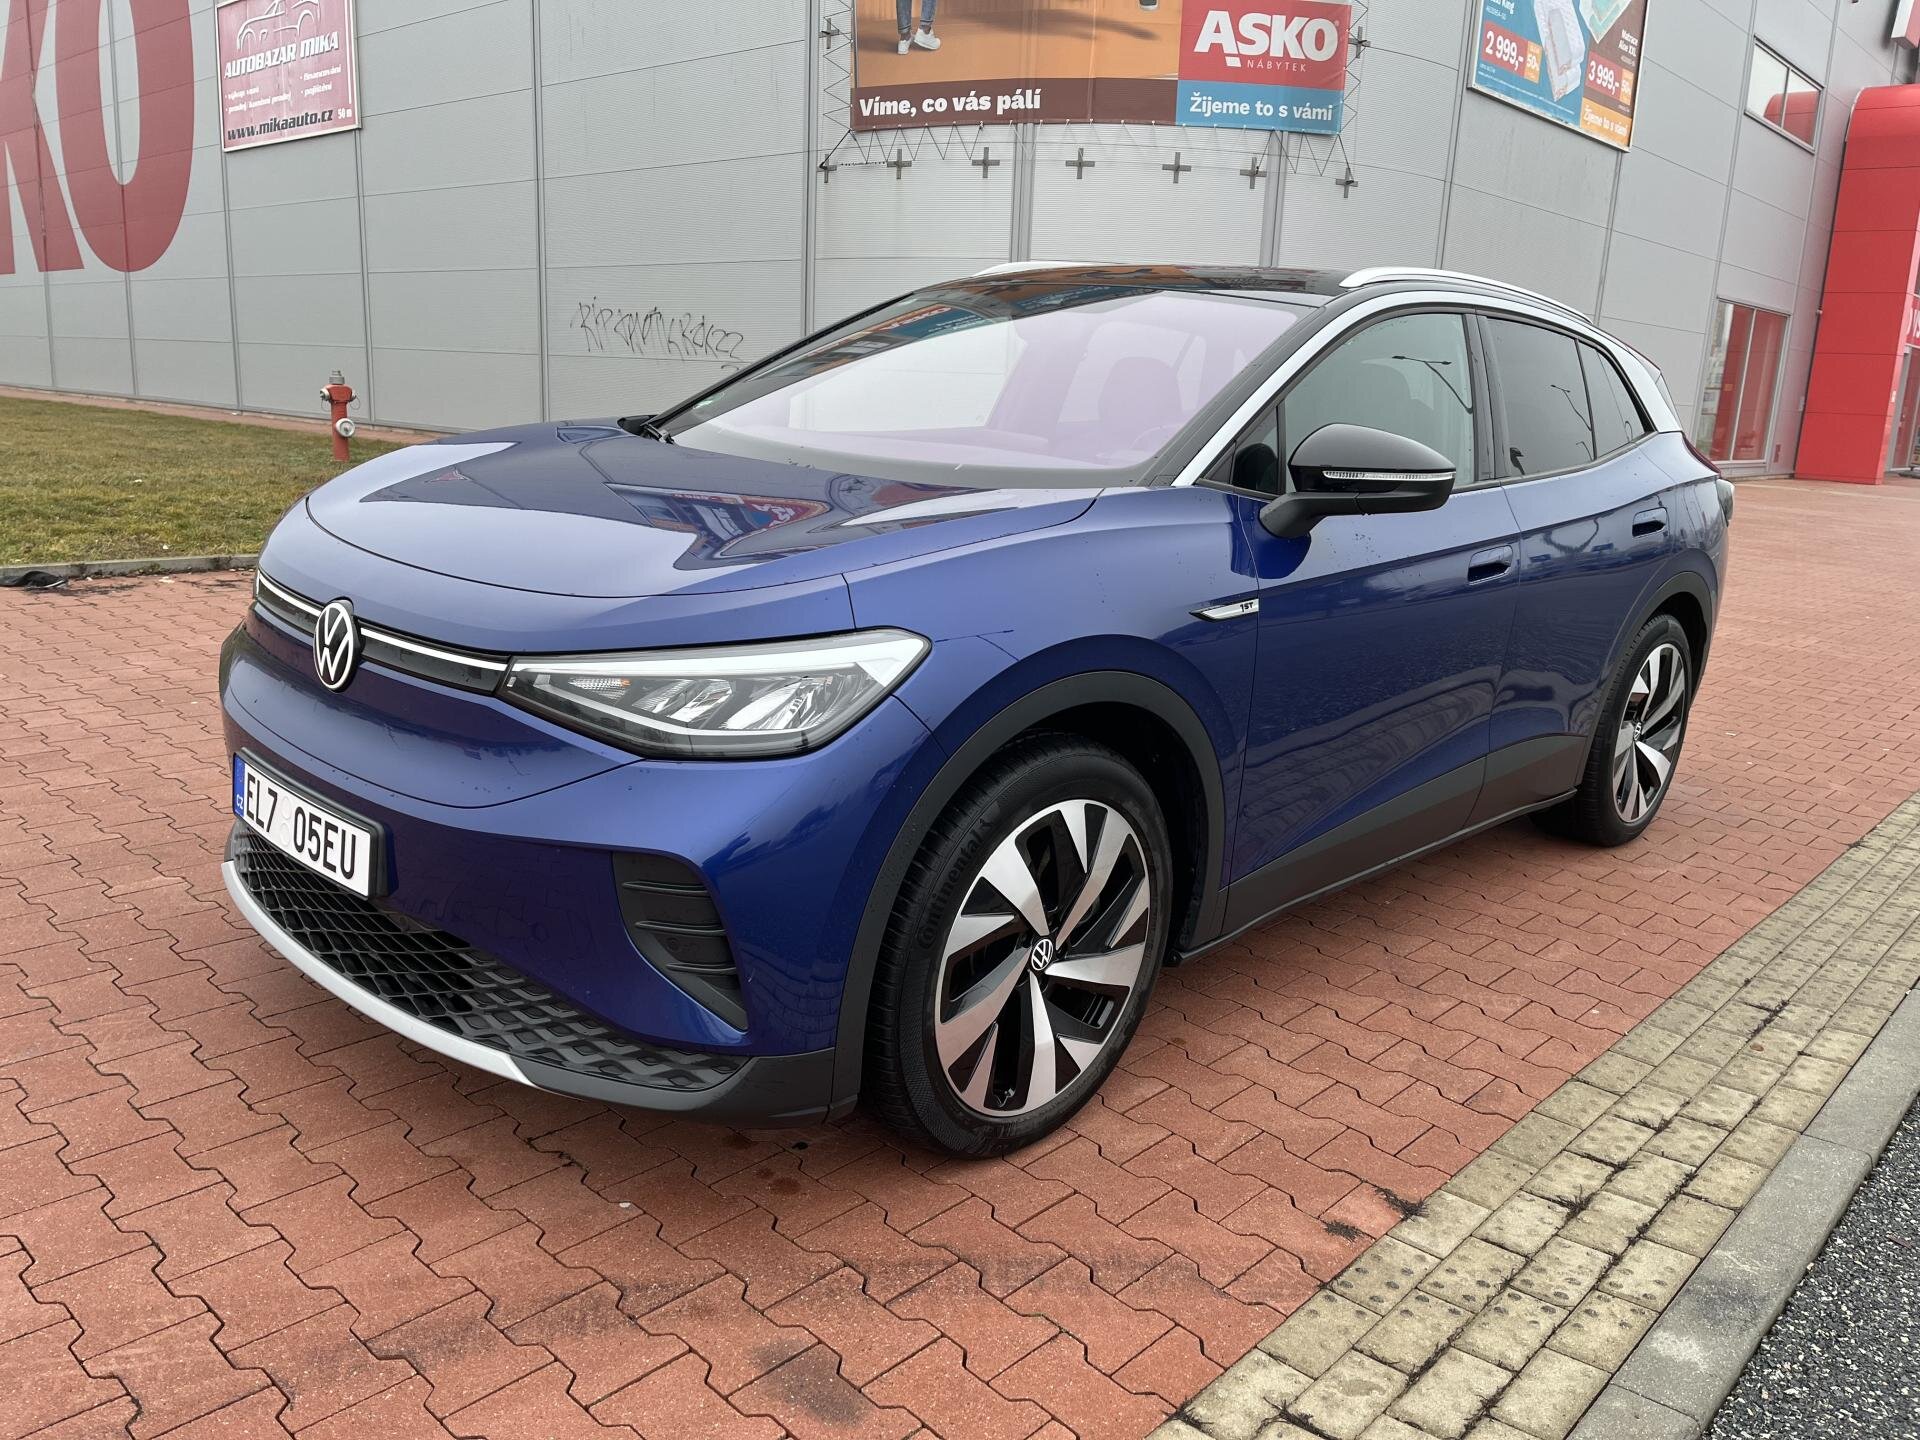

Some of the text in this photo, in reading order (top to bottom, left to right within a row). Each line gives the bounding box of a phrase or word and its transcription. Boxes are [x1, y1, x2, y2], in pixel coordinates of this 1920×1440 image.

[1194, 10, 1338, 63] ASKO
[224, 31, 339, 79] AUTOBAZAR MIKA
[1247, 59, 1306, 72] NÁBYTEK
[859, 89, 1042, 117] Víme, co vás pálí
[1190, 92, 1333, 121] Žijeme to s vámi
[227, 109, 334, 141] www.mikaauto.cz
[1240, 602, 1253, 612] 1ST
[236, 793, 244, 810] CZ
[247, 772, 357, 880] EL7 05EU
